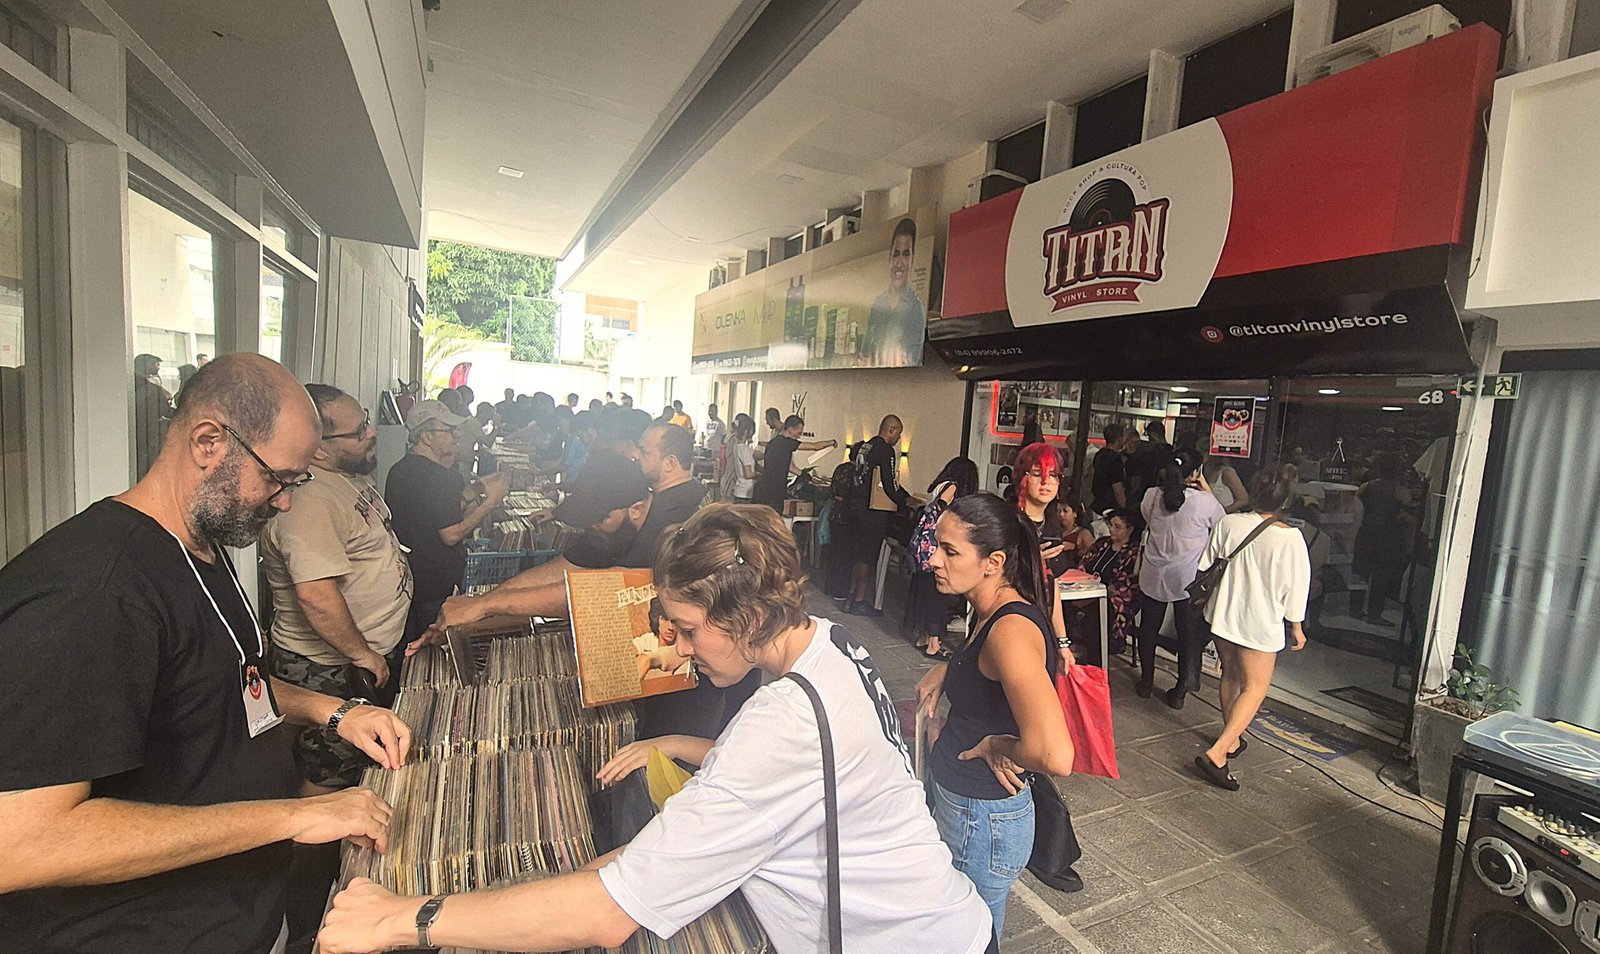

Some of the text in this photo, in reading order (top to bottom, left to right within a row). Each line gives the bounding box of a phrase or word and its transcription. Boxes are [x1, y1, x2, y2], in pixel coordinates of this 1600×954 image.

[1106, 162, 1137, 176] CULTURA
[1136, 174, 1147, 190] POP
[1047, 204, 1163, 290] TITAN
[1061, 287, 1129, 304] VINYL STORE
[715, 308, 747, 330] OLENKA
[1228, 312, 1409, 337] @titanvinylstore
[1418, 390, 1444, 404] 68
